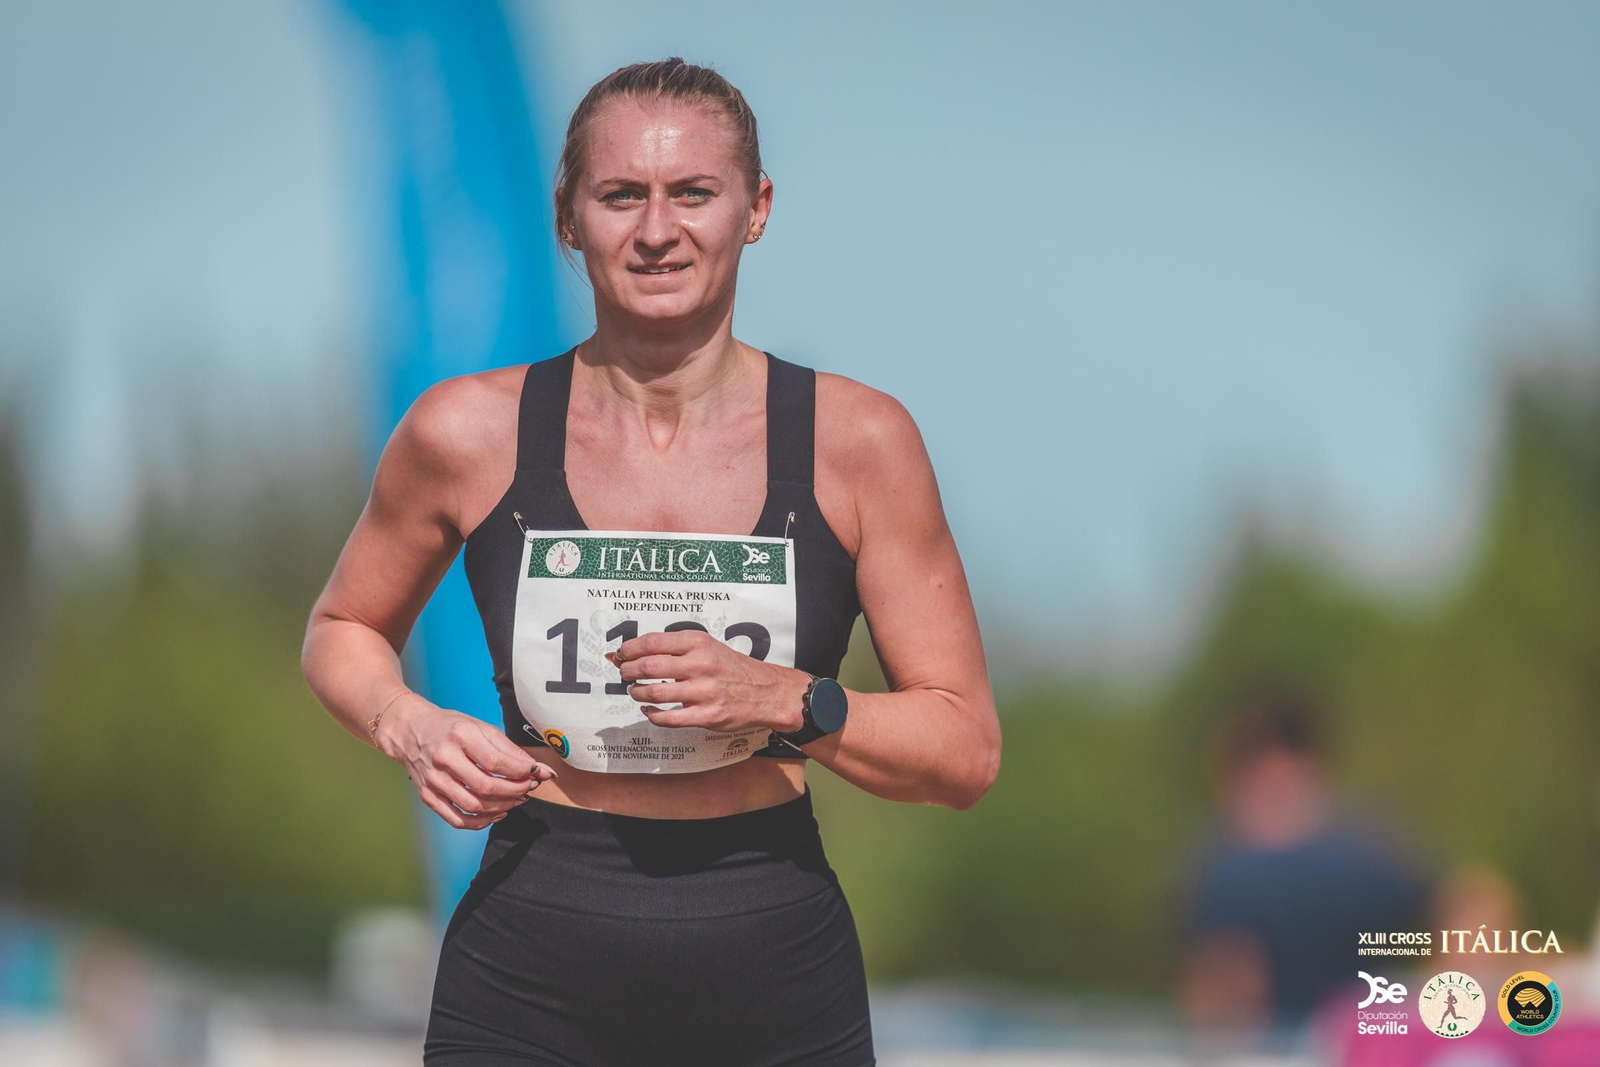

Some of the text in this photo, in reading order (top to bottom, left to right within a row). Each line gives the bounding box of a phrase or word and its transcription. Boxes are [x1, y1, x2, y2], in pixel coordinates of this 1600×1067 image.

[597, 541, 723, 574] ITÁLICA
[597, 571, 658, 580] INTERNATIONAL
[742, 573, 771, 582] Sevilla
[587, 588, 731, 602] NATALIA PRUSKA PRUSKA
[613, 602, 704, 613] INDEPENDIENTE
[545, 618, 771, 695] 112
